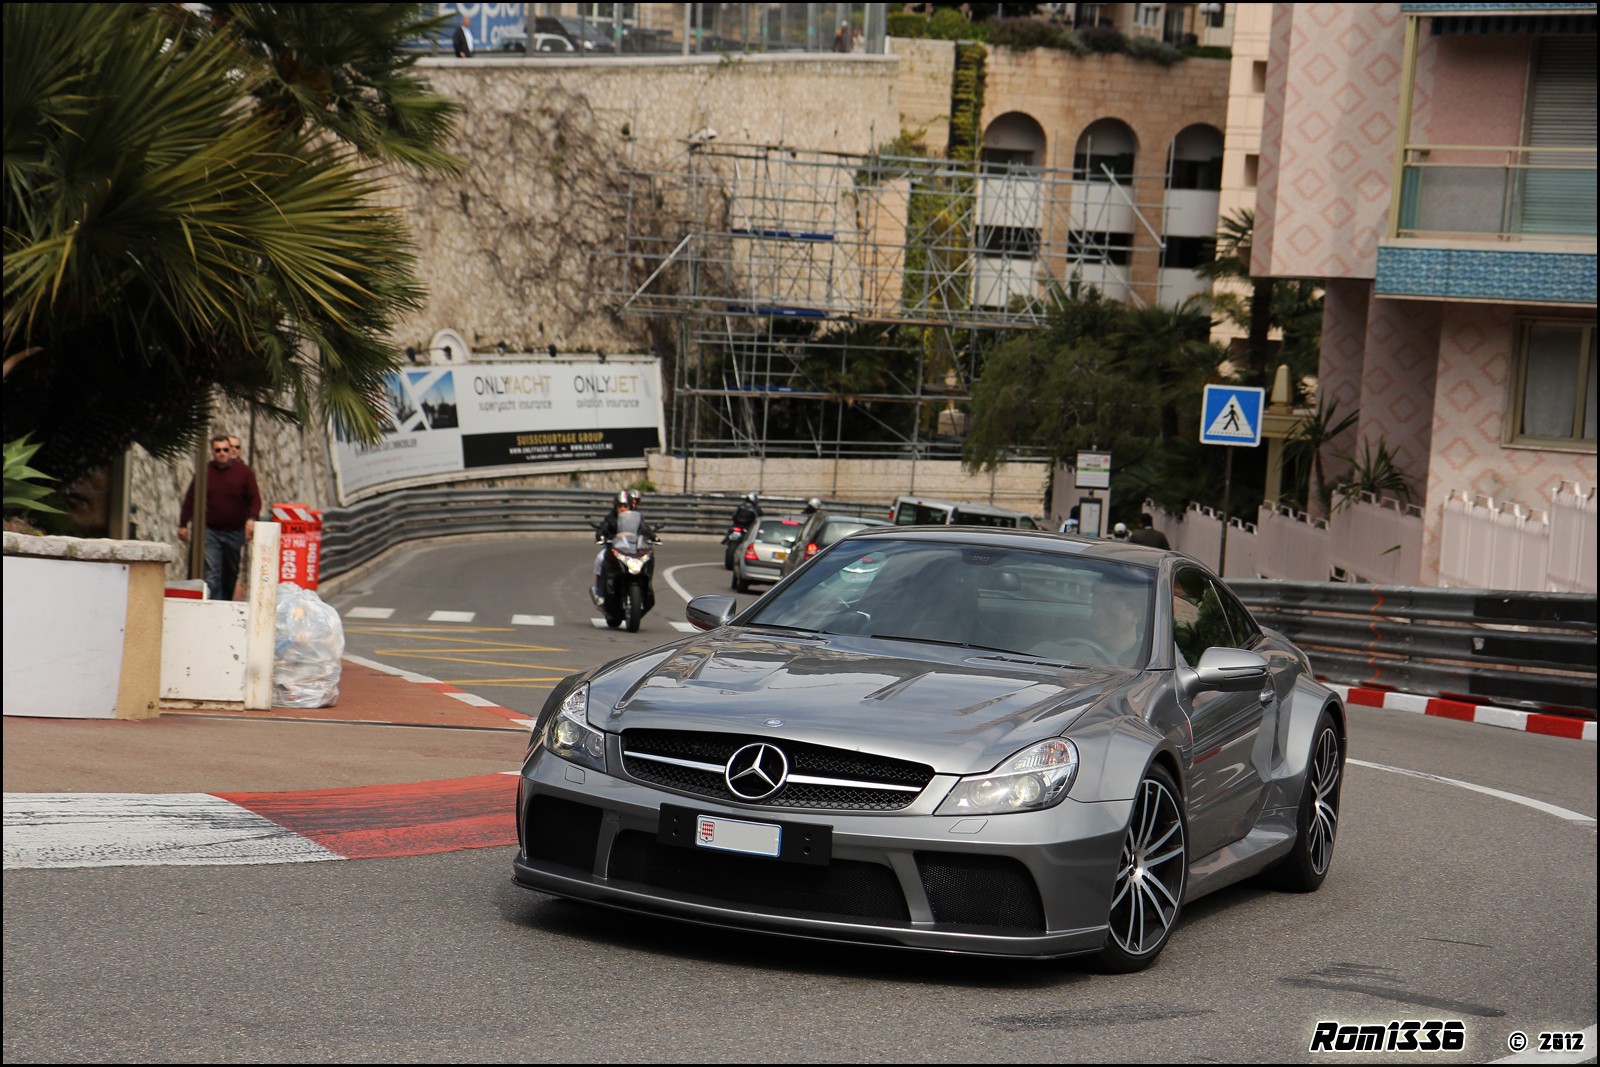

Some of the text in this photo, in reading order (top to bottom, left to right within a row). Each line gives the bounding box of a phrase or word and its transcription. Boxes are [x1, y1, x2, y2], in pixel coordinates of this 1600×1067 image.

[574, 375, 639, 394] ONLYJET
[518, 399, 552, 410] insurance
[606, 398, 640, 409] insurance
[577, 431, 604, 443] GROUP
